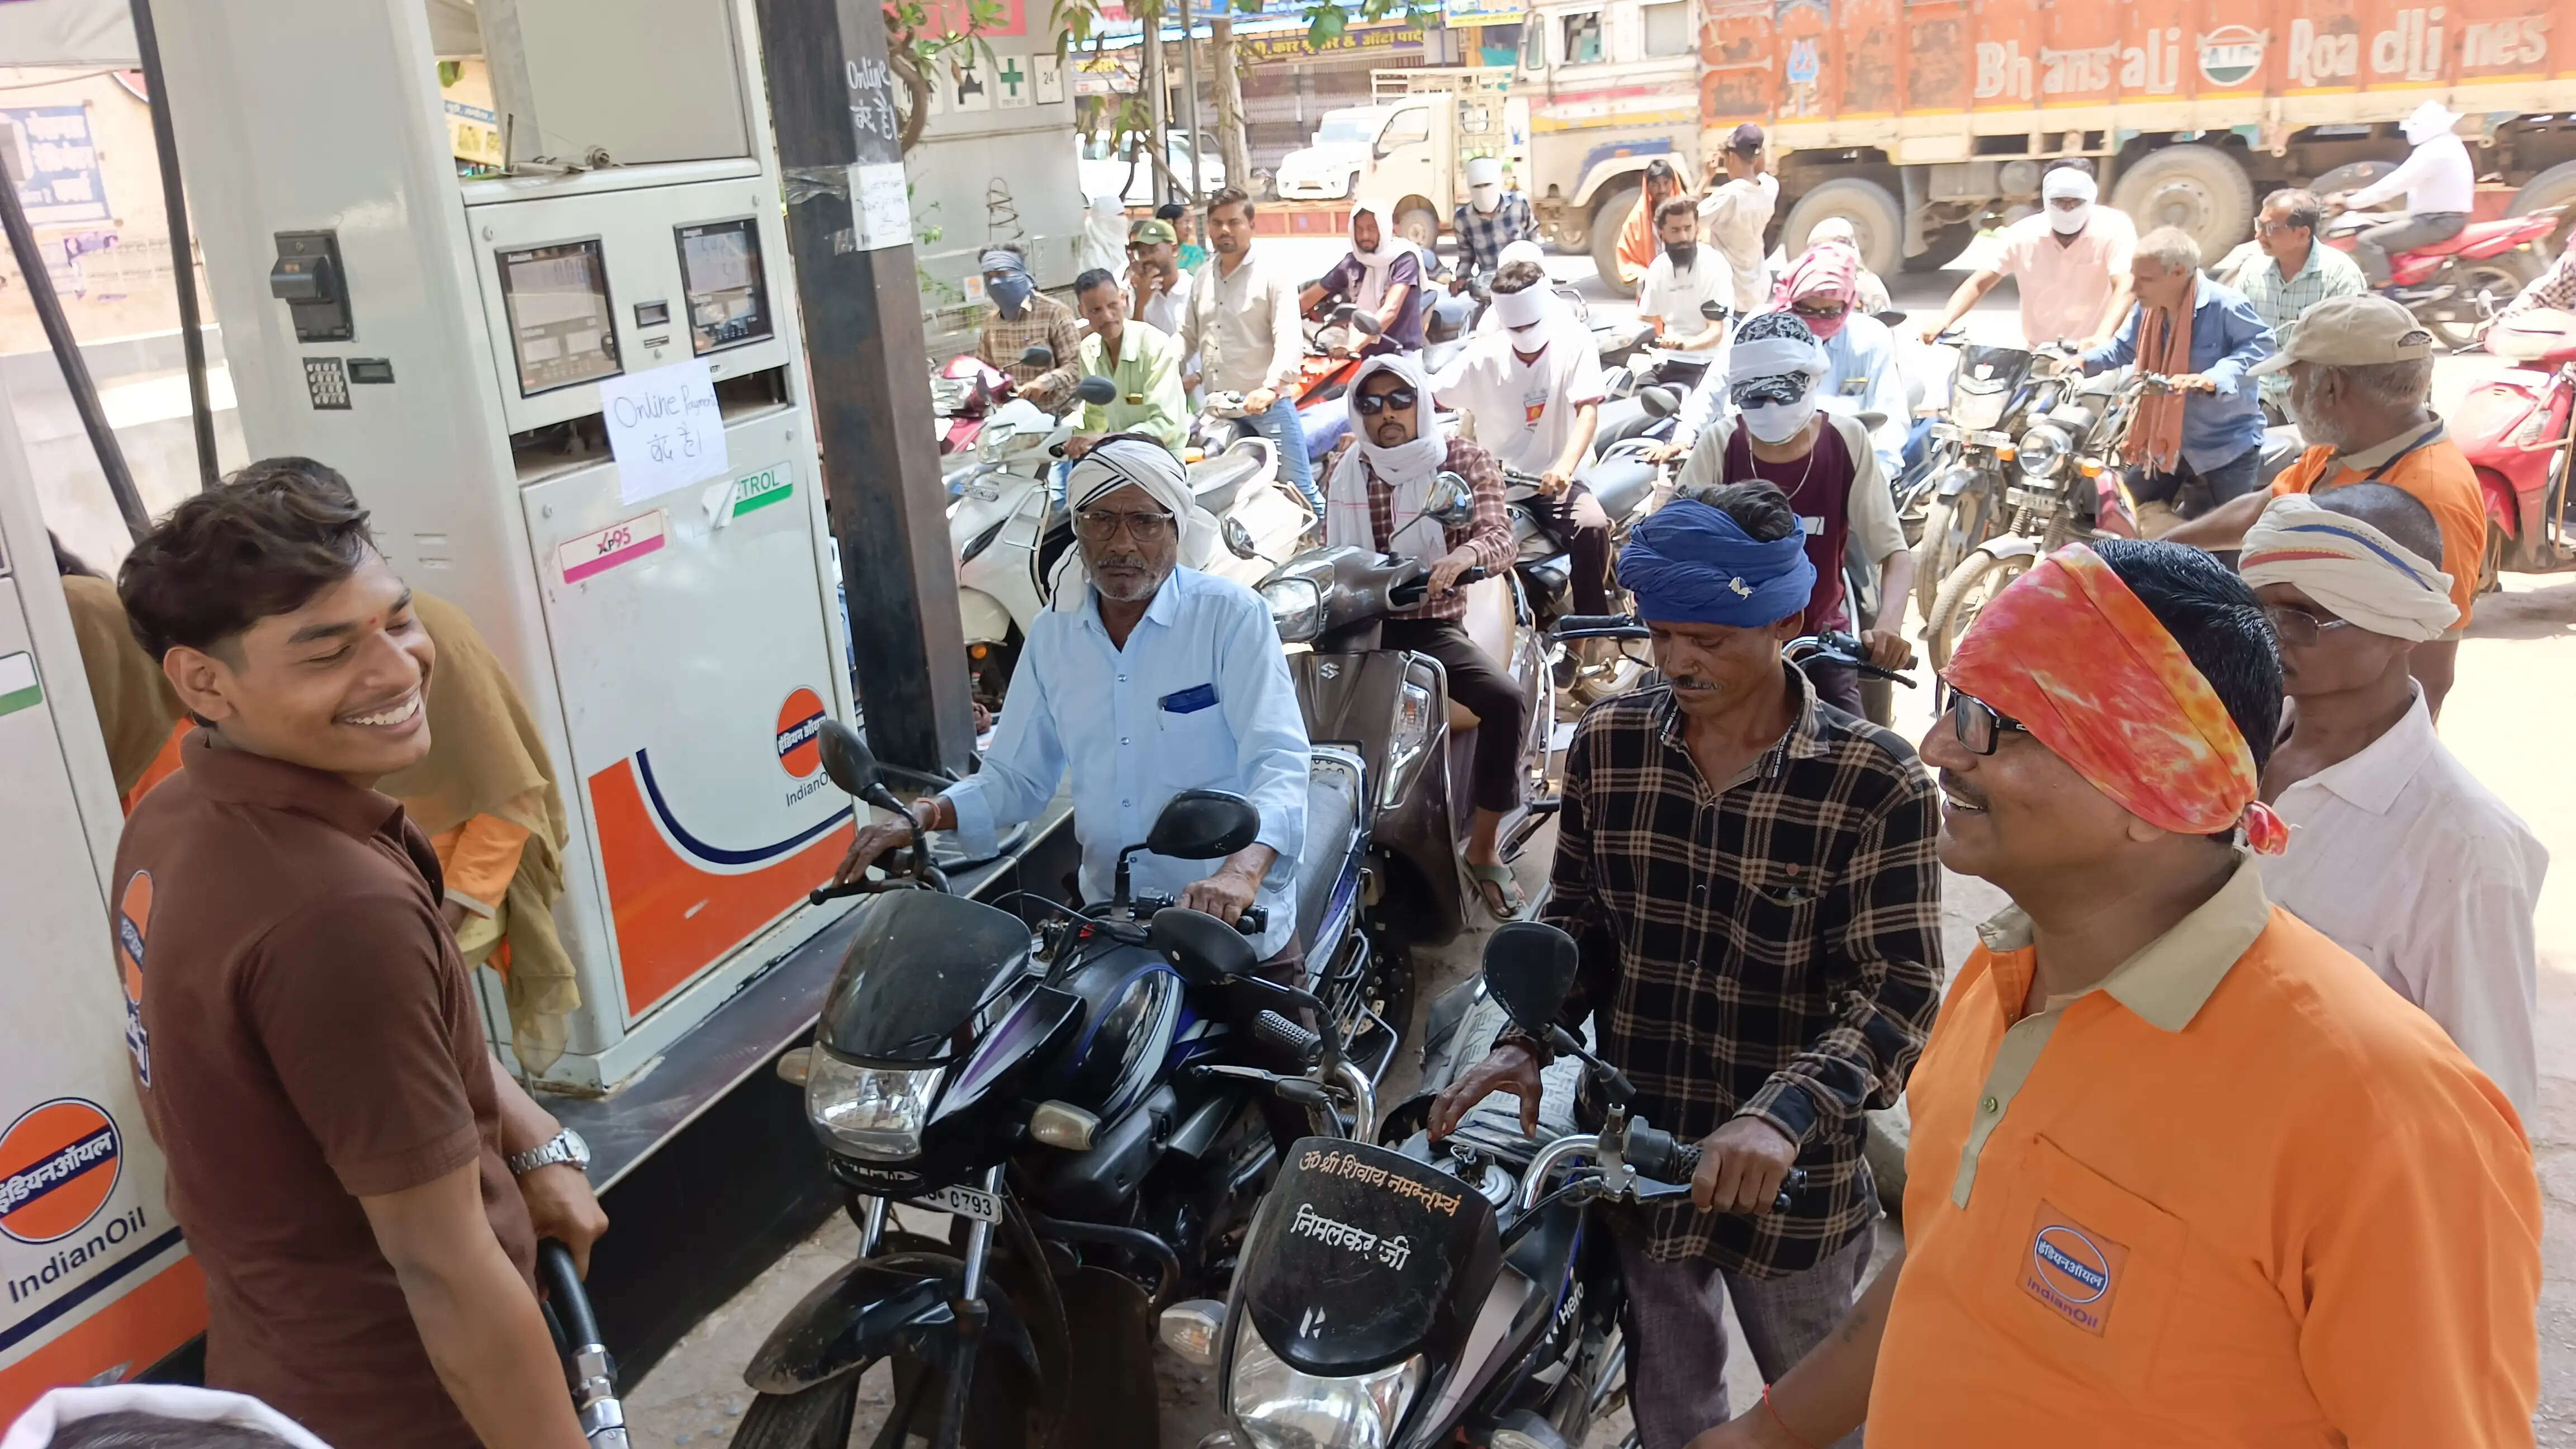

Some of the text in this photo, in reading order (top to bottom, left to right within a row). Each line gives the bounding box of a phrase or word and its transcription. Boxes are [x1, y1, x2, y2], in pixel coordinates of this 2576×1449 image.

[846, 56, 891, 89] Online
[614, 392, 680, 428] Online
[786, 771, 832, 807] IndianO
[1337, 1154, 1389, 1187] शिवाय
[8, 1206, 146, 1304] IndianOil
[1379, 1235, 1411, 1271] जी
[1558, 1281, 1584, 1325] Hero
[2026, 1276, 2098, 1328] IndianOil
